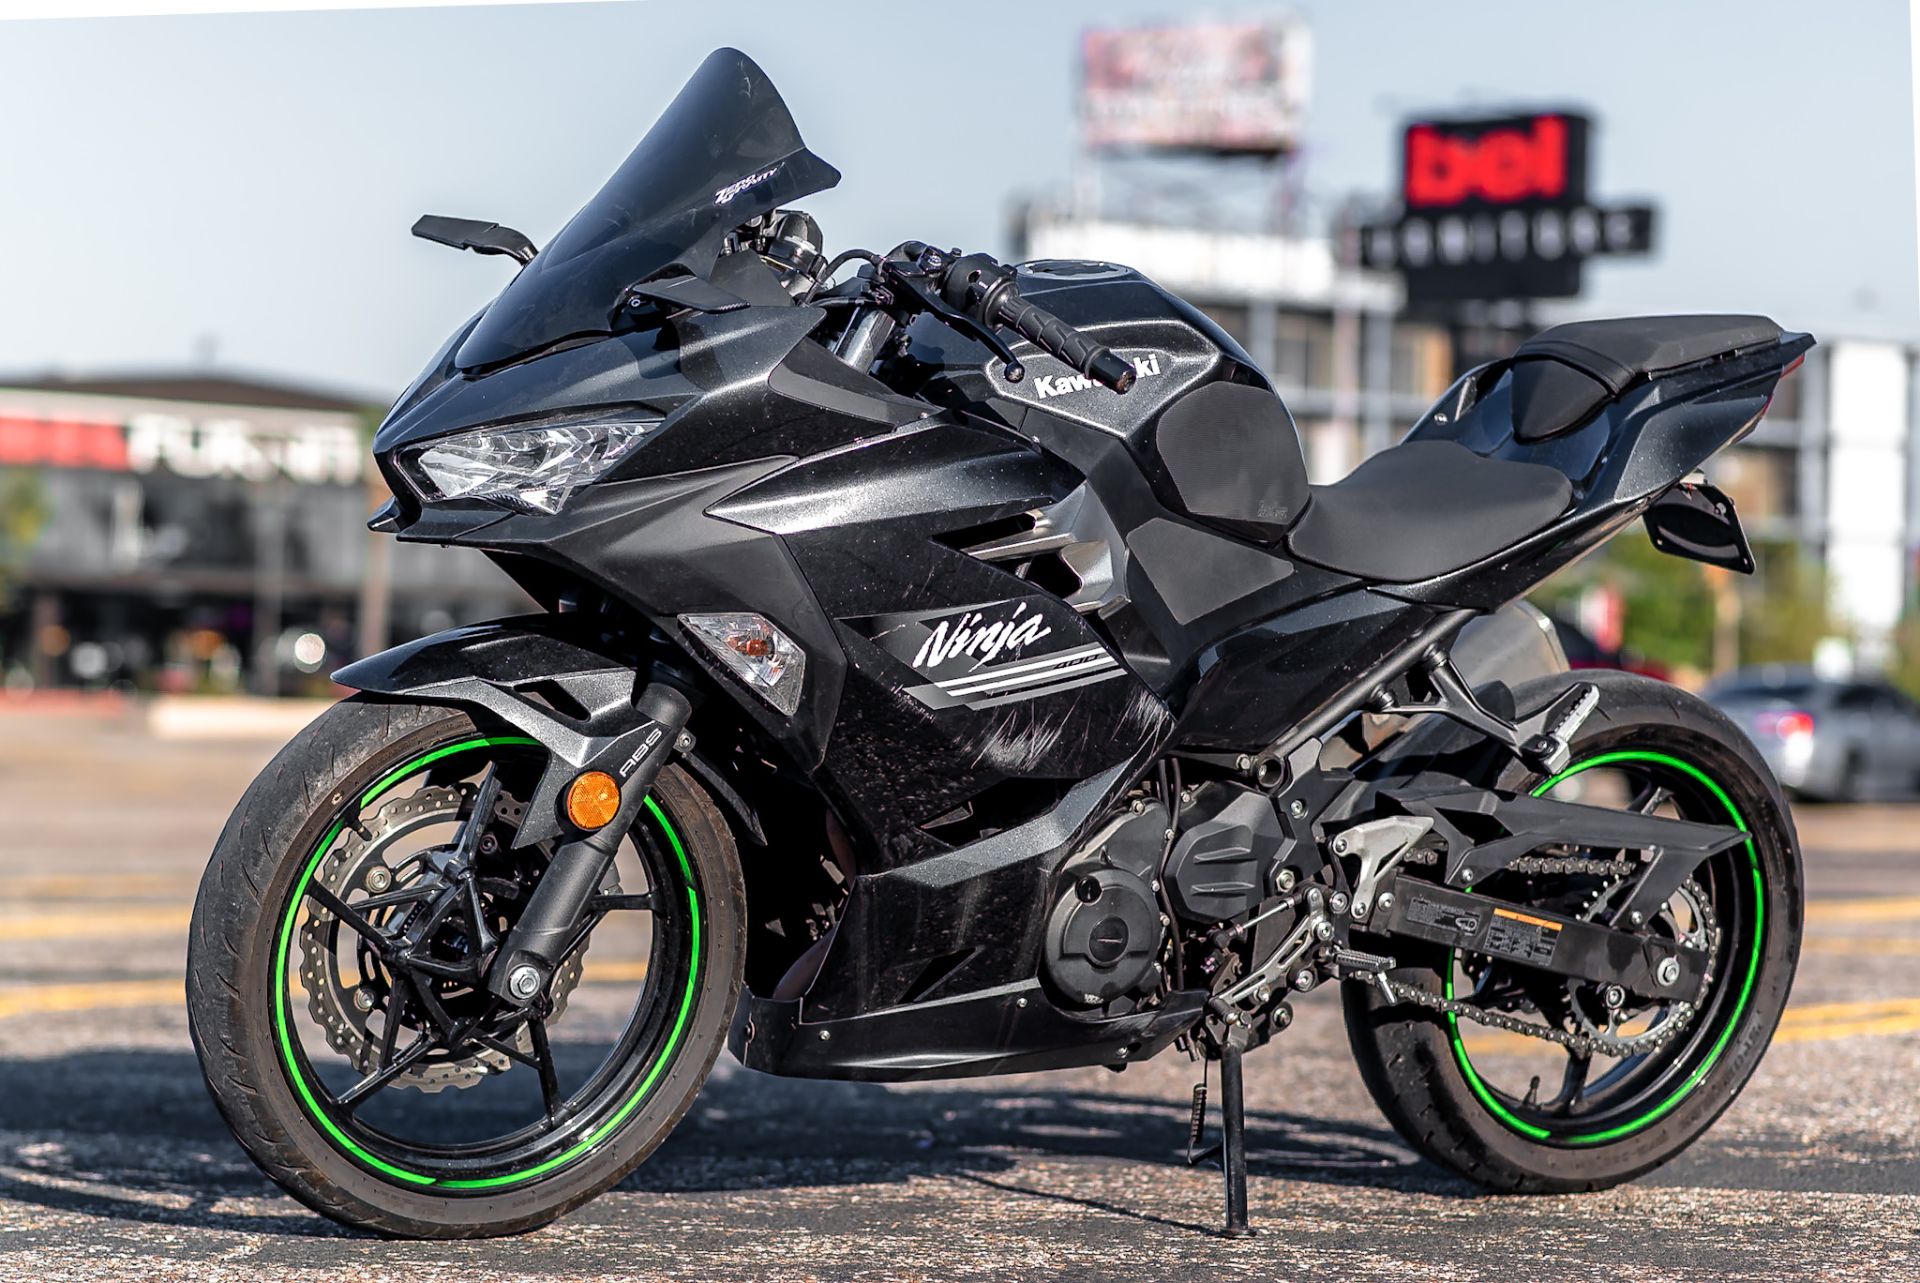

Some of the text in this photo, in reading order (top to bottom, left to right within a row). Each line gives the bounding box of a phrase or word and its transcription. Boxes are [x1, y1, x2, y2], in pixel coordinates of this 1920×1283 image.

[1033, 353, 1161, 399] Kawki
[912, 601, 1052, 673] Ninja
[1053, 654, 1100, 670] 400
[619, 728, 662, 777] ABS
